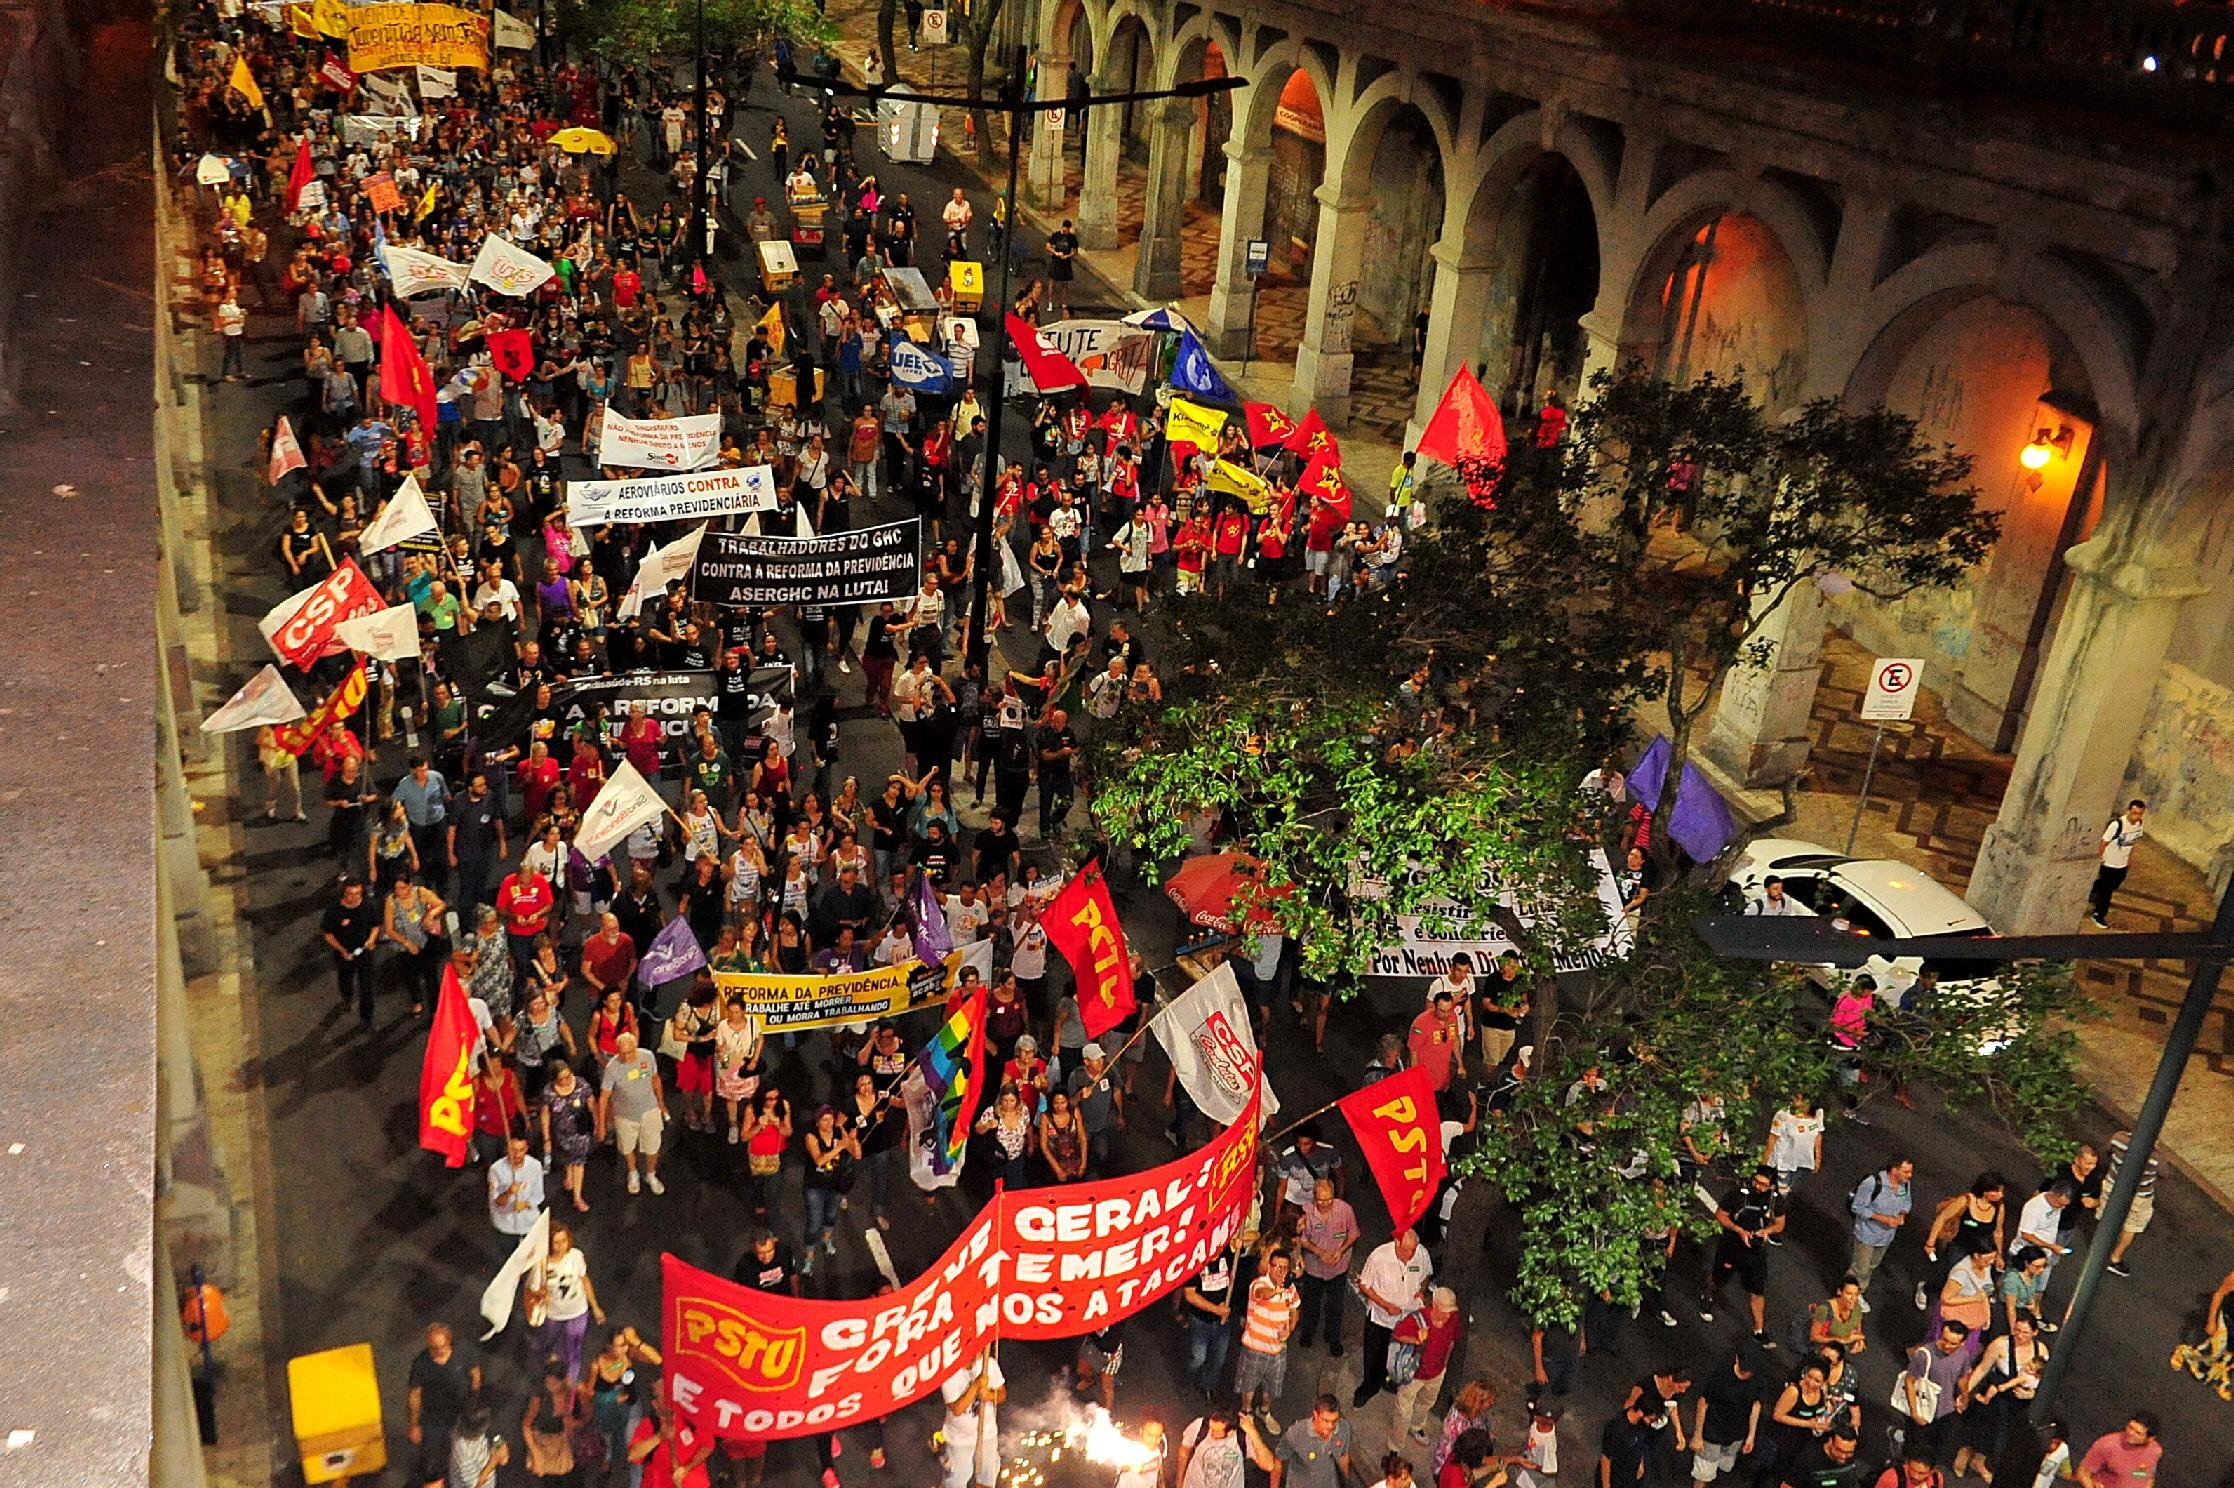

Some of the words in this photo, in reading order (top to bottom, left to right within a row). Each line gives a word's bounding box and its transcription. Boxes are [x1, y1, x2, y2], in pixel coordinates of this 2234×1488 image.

[671, 430, 717, 440] PREIDÊNCIA
[619, 480, 685, 500] AEROVIÁRIOS
[687, 476, 740, 493] CONTRA
[614, 506, 668, 520] REFORMA
[670, 493, 760, 515] PREVIDENCIÁRIA
[718, 537, 846, 556] TRABALHADORES
[850, 535, 868, 550] DO
[872, 527, 902, 548] GHC
[701, 561, 752, 580] CONTRA
[767, 560, 823, 580] REFORMA
[825, 559, 841, 576] DA
[843, 551, 915, 576] PREVIDÊNCIA
[729, 585, 813, 602] ASERGHC
[817, 585, 840, 600] NA
[844, 579, 889, 597] LUTA!
[284, 567, 354, 649] CSP
[653, 677, 667, 685] na
[668, 675, 690, 684] luta
[1889, 669, 1903, 686] E
[1371, 947, 1400, 974] Por
[724, 986, 788, 1001] REFORMA
[795, 986, 813, 999] DA
[819, 975, 900, 997] PREVIDÊNCIA
[745, 1001, 789, 1014] RABALHE
[793, 1000, 810, 1012] ATÉ
[814, 995, 852, 1010] MORRER
[769, 1014, 783, 1024] OU
[786, 1012, 821, 1024] MORRA
[824, 1001, 889, 1017] TRABALHANDO
[1214, 1020, 1255, 1079] CSP
[821, 1219, 992, 1350] GREVE
[808, 1291, 954, 1398] FORA
[979, 1205, 1196, 1288] TEMER!
[684, 1309, 797, 1379] PSTU
[672, 1373, 704, 1414] E
[713, 1392, 863, 1432] TODOS
[891, 1326, 963, 1400] QUE
[976, 1292, 1064, 1339] NOS
